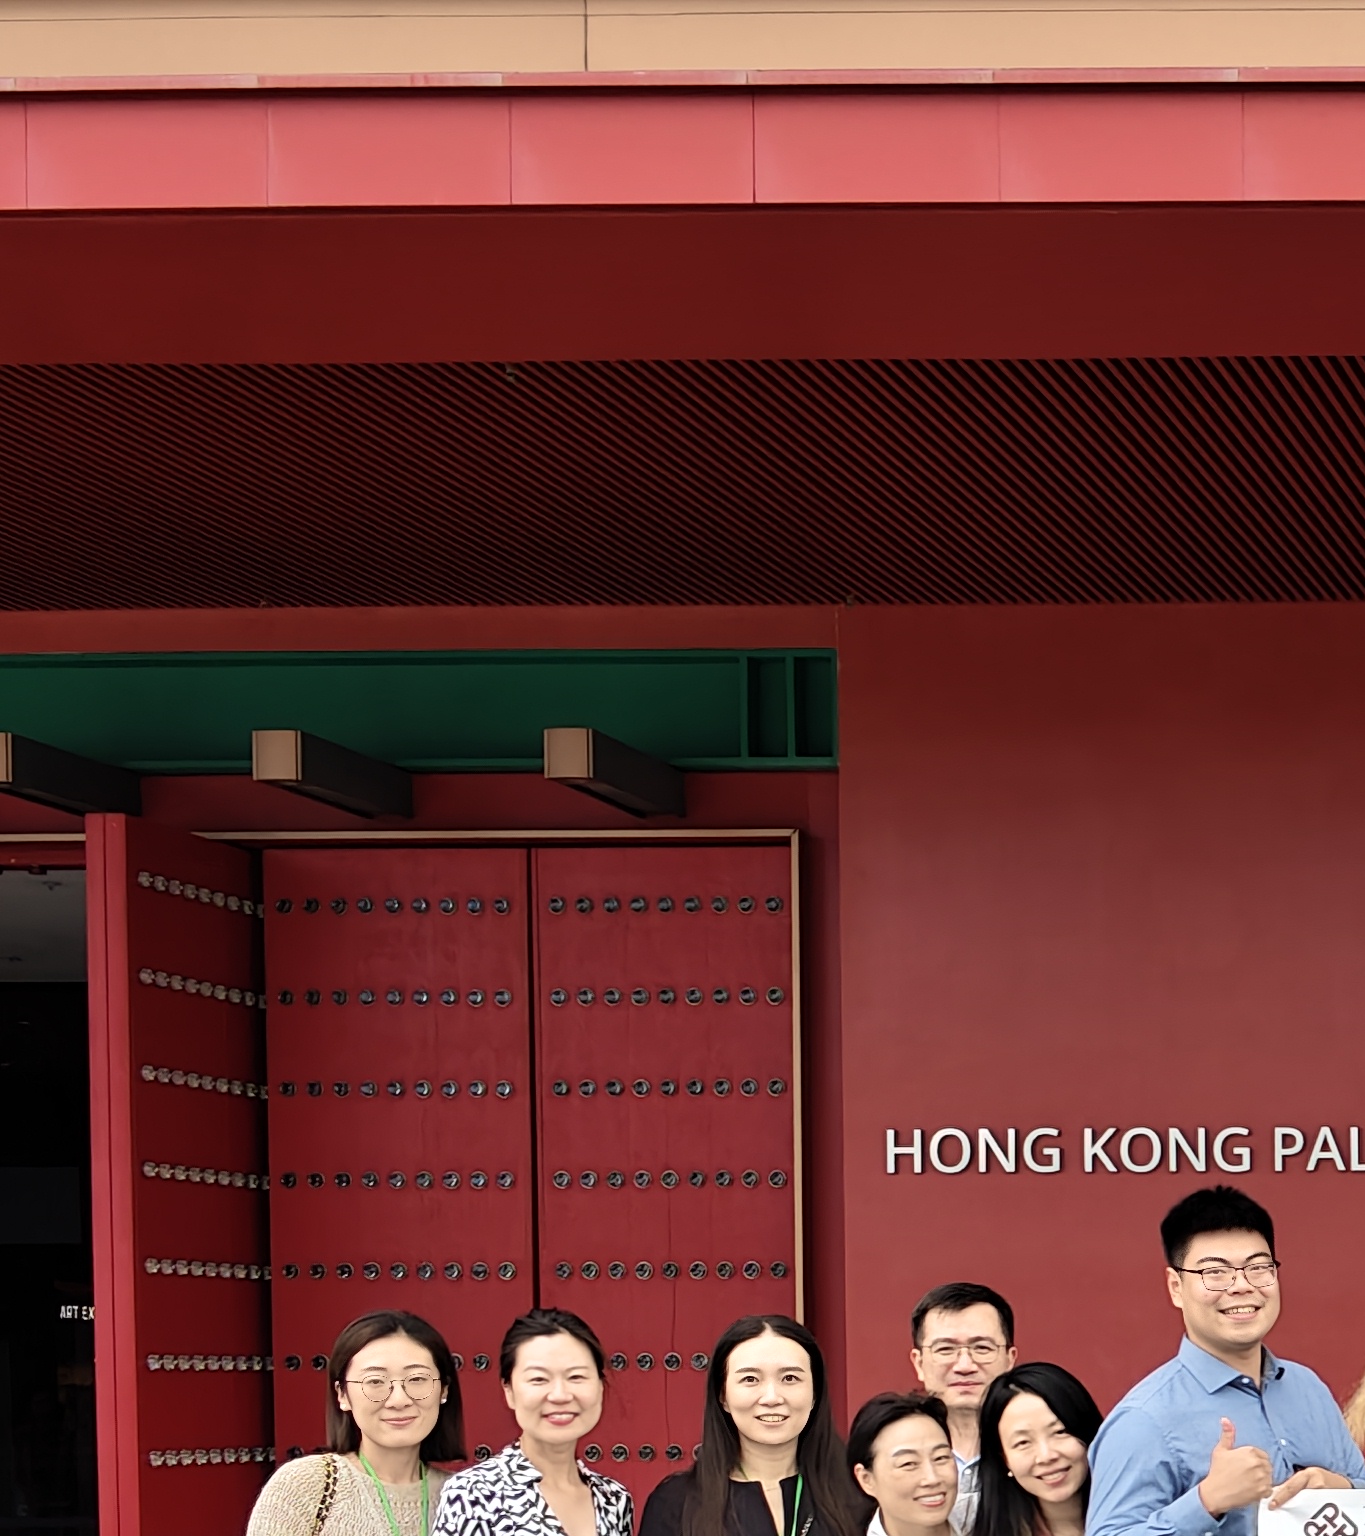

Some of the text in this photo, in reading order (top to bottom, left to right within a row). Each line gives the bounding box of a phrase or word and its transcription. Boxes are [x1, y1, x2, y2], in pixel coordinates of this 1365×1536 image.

[886, 1127, 1061, 1174] HONG
[1083, 1126, 1251, 1173] KONG
[59, 1305, 79, 1319] ART
